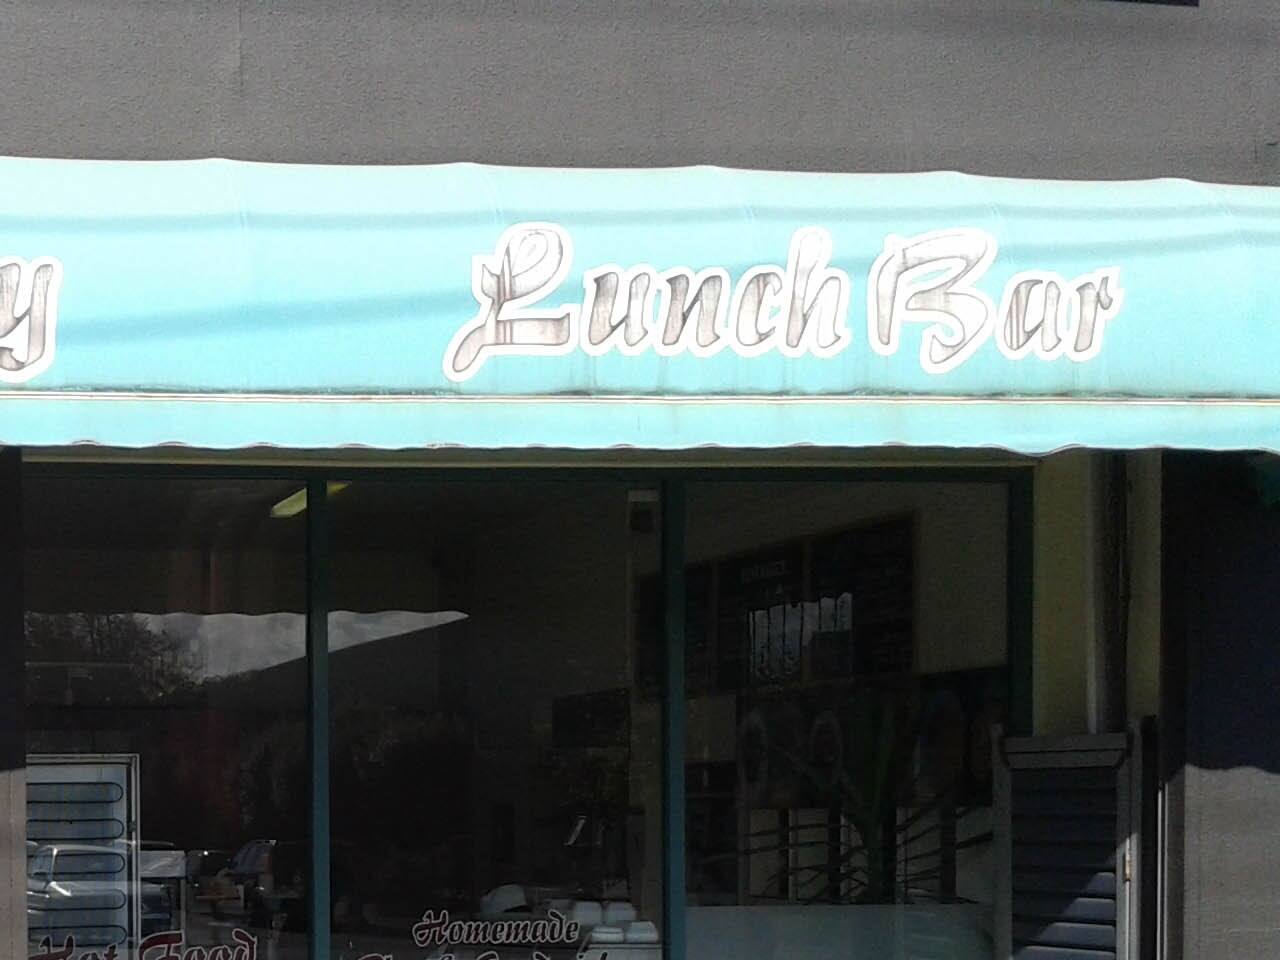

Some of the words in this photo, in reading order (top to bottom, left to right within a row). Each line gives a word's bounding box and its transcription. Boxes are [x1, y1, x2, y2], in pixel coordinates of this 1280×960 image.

[447, 225, 848, 373] Lunch
[870, 229, 1118, 367] Bar
[412, 908, 580, 946] Homemade
